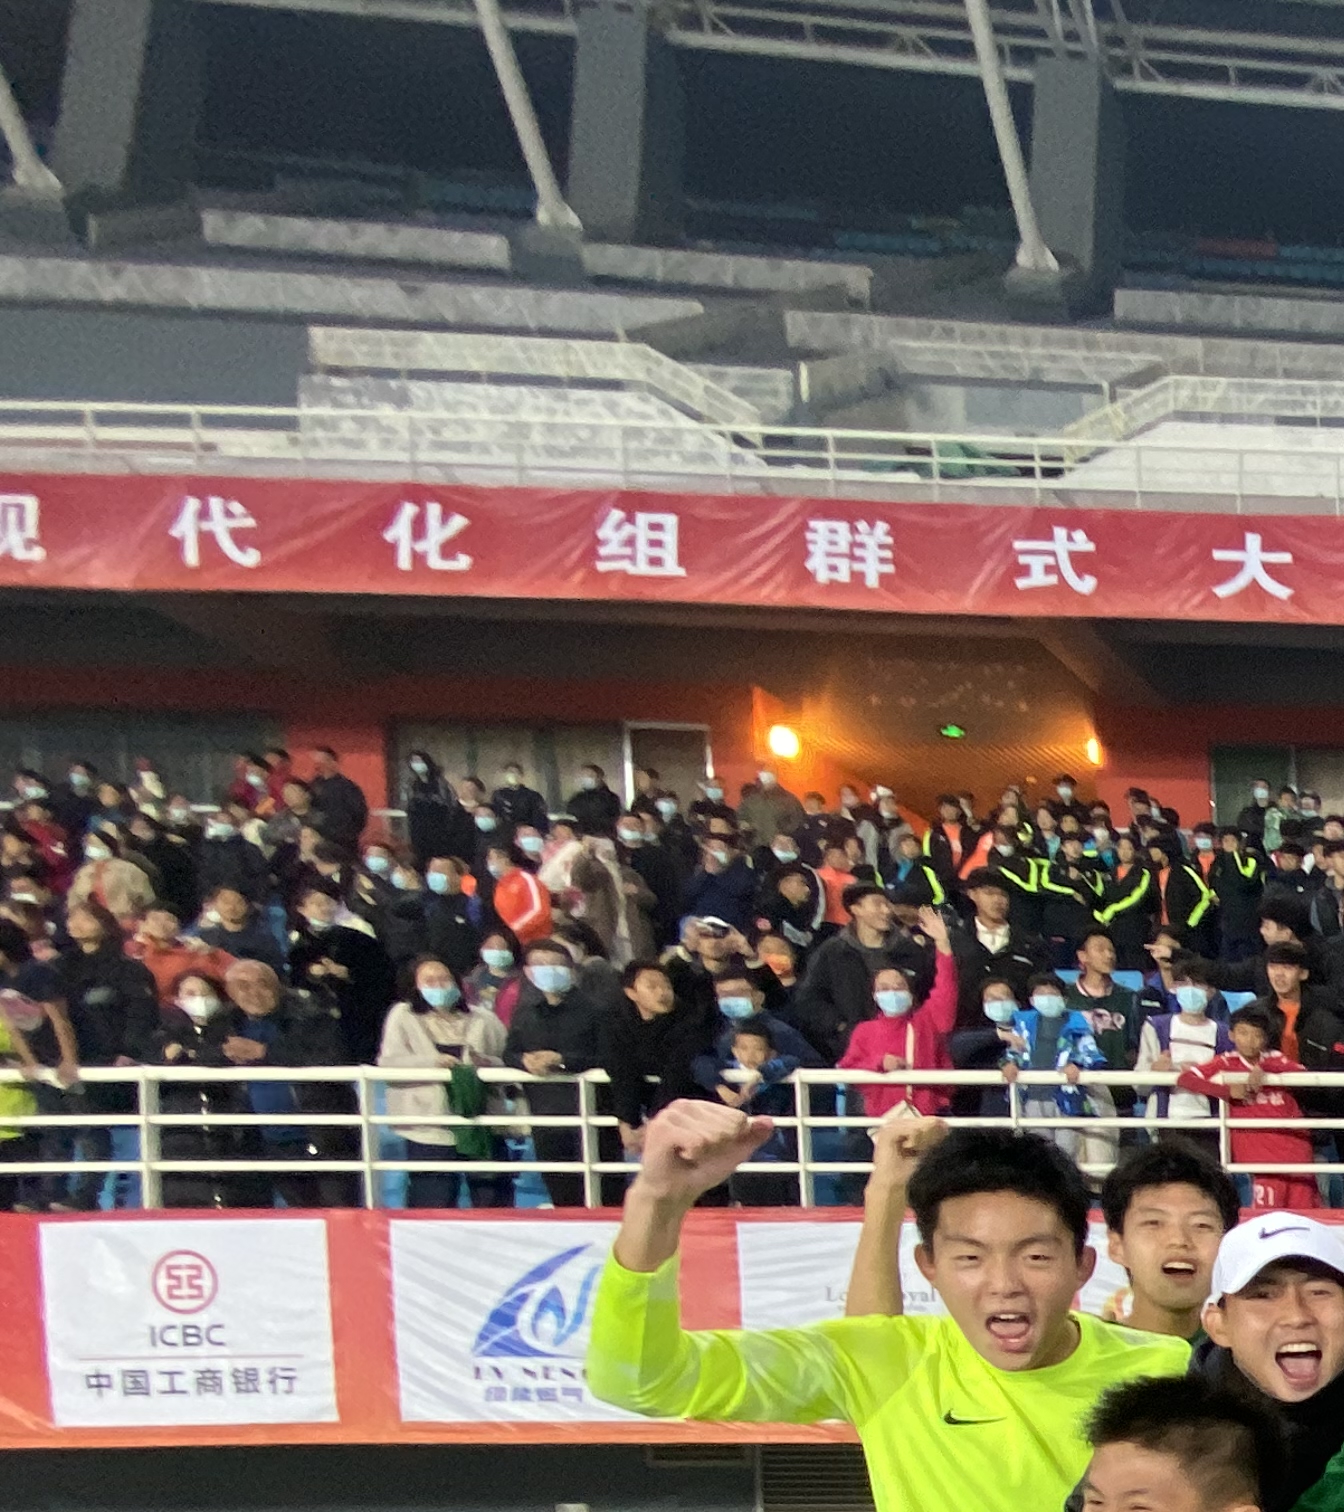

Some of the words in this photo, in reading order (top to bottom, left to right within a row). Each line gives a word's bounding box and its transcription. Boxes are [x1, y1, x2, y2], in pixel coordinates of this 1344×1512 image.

[150, 1325, 226, 1347] ICBC
[84, 1366, 298, 1399] 中国工商银行
